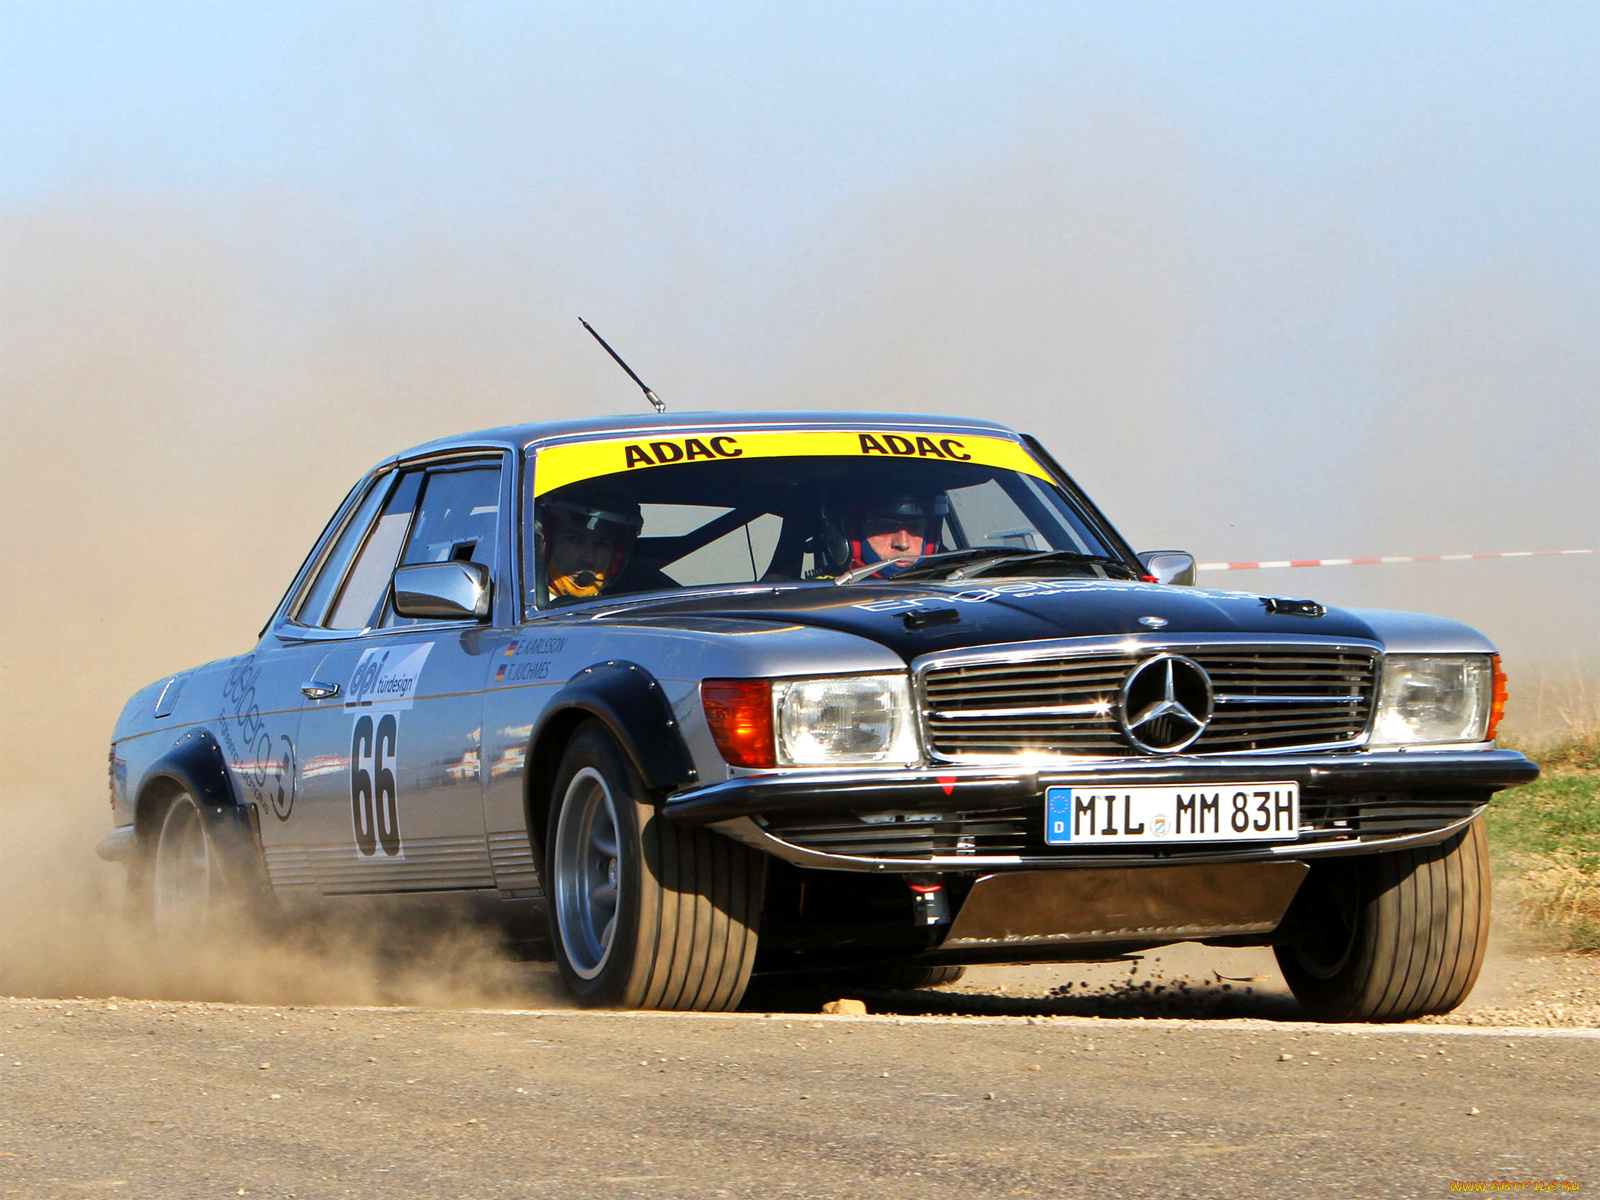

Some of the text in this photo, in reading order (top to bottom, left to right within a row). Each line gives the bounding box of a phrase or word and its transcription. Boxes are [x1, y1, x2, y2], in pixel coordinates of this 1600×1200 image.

[624, 436, 743, 469] ADAC
[858, 432, 972, 462] ADAC
[350, 651, 413, 702] dpi türdesign
[352, 714, 401, 857] 66
[1054, 791, 1293, 836] D MIL MM 83H
